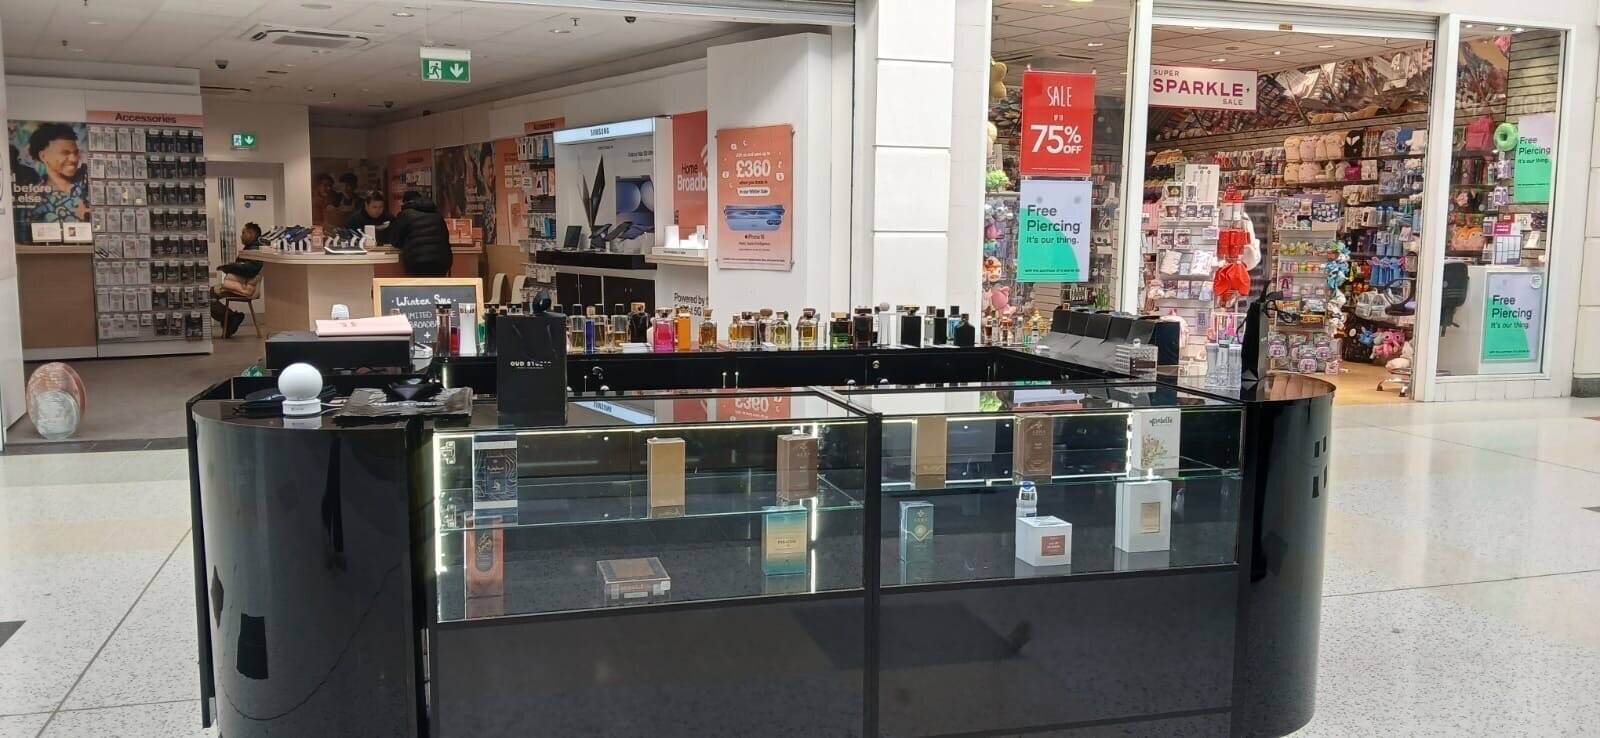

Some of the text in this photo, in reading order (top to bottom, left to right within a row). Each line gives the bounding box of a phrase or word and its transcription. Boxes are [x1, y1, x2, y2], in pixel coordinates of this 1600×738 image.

[1153, 69, 1180, 77] SUPER
[1153, 78, 1243, 97] SPARKLE
[1047, 86, 1073, 107] SALE
[1223, 98, 1243, 106] SALE
[115, 112, 177, 124] Accessories
[590, 127, 610, 136] SAMSUNG
[1030, 124, 1082, 154] 75%
[1519, 136, 1538, 145] Free
[1063, 145, 1083, 154] OFF
[1518, 147, 1551, 157] Piercing
[681, 163, 698, 175] Home
[736, 159, 771, 178] £360
[13, 183, 52, 193] before
[18, 193, 41, 203] else
[1026, 204, 1057, 217] Free
[1026, 219, 1081, 235] Piercing
[1039, 237, 1055, 245] our
[396, 296, 432, 307] Winter
[674, 292, 704, 306] Powered by
[1492, 294, 1516, 305] Free
[407, 311, 433, 320] IMITED
[1491, 307, 1532, 320] Piercing
